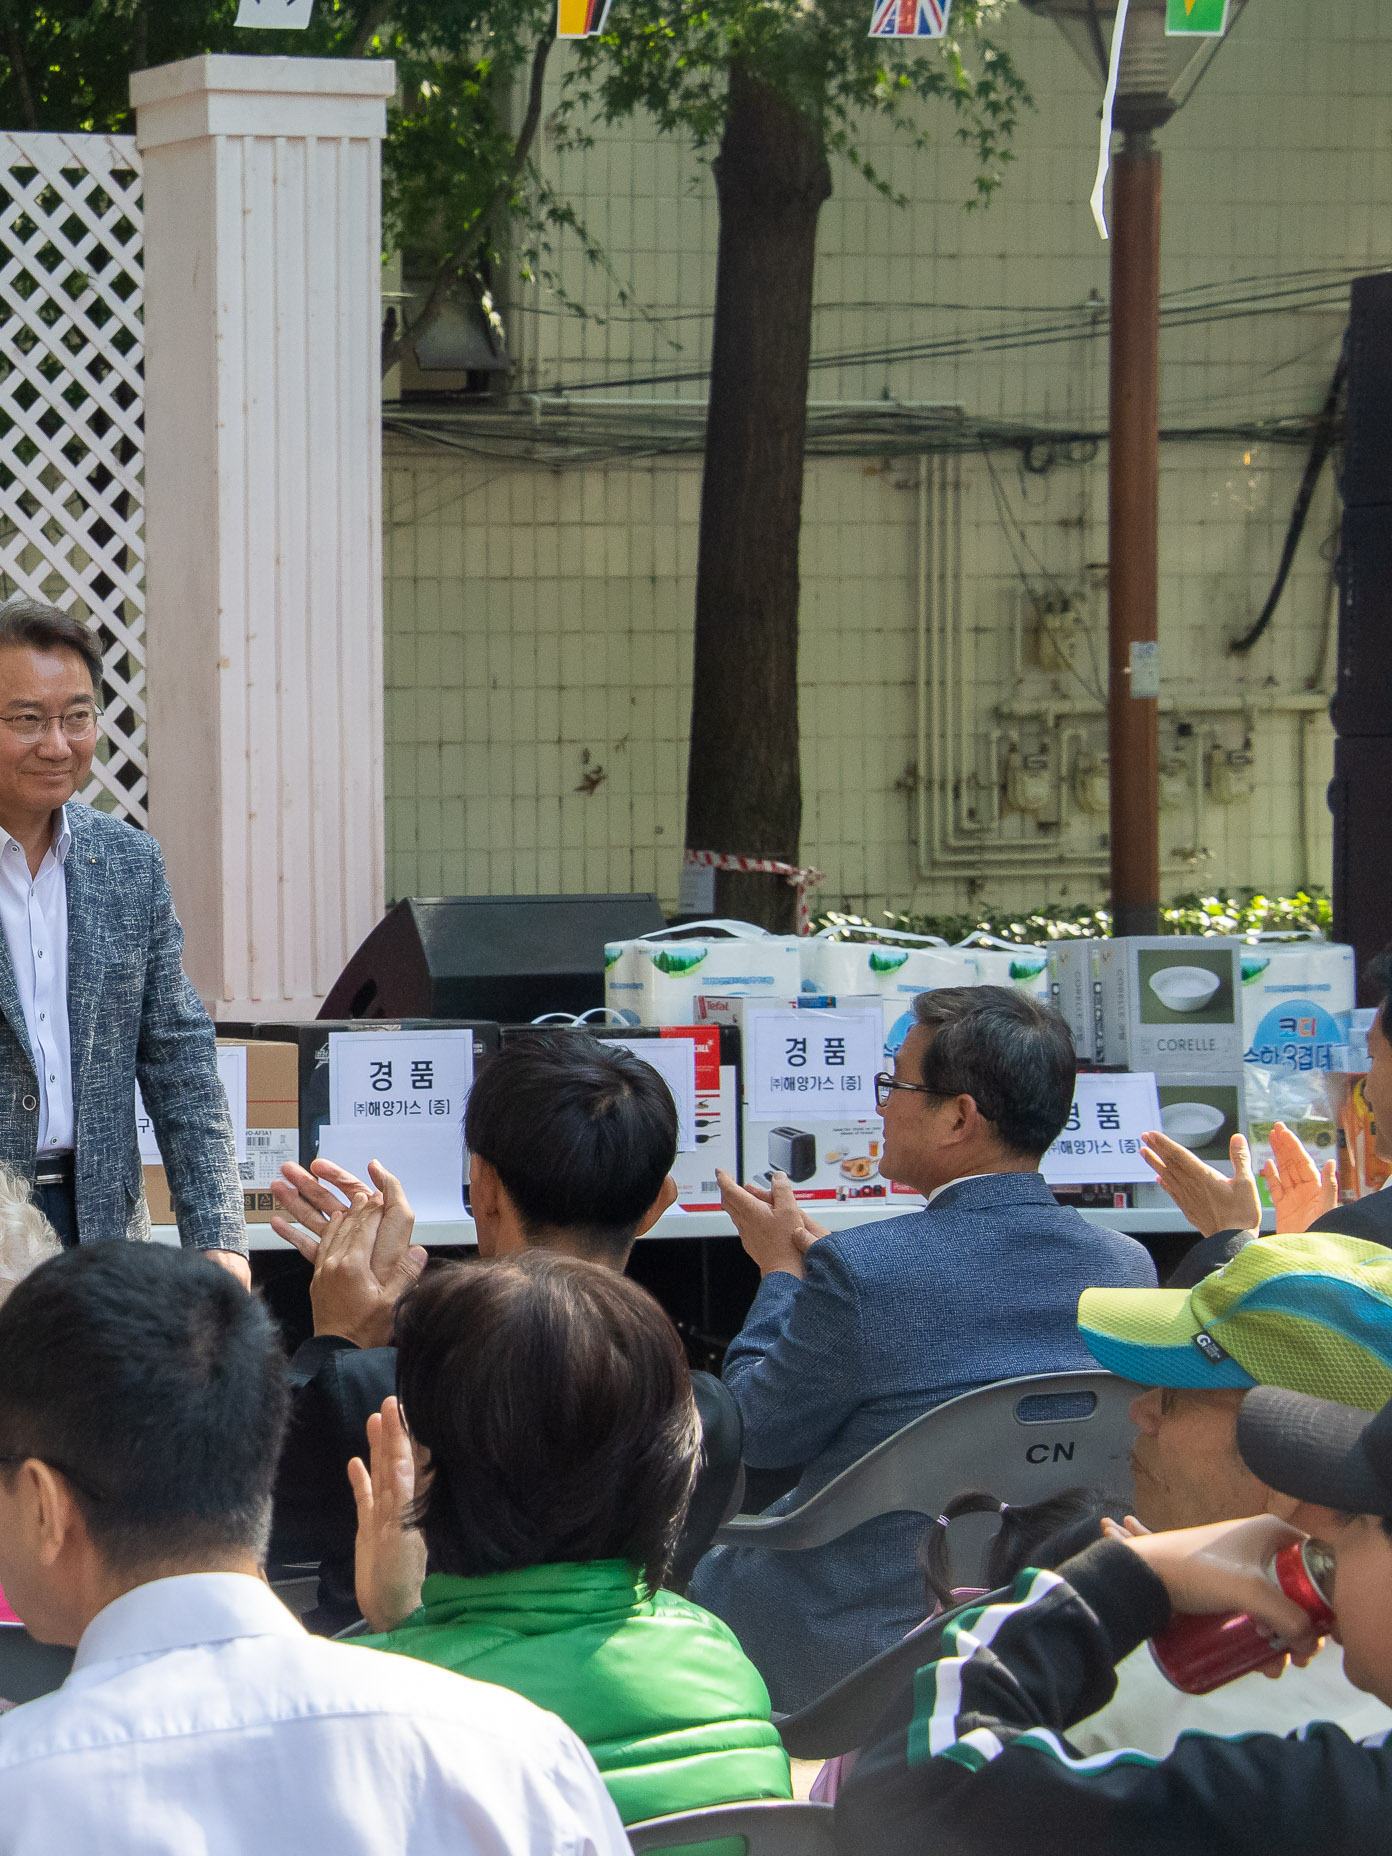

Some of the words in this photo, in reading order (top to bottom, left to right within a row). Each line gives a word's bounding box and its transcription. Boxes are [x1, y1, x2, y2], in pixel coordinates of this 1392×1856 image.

[1279, 1017, 1317, 1038] 코디
[1157, 1037, 1217, 1052] CORELLE
[1025, 1440, 1076, 1465] CN
